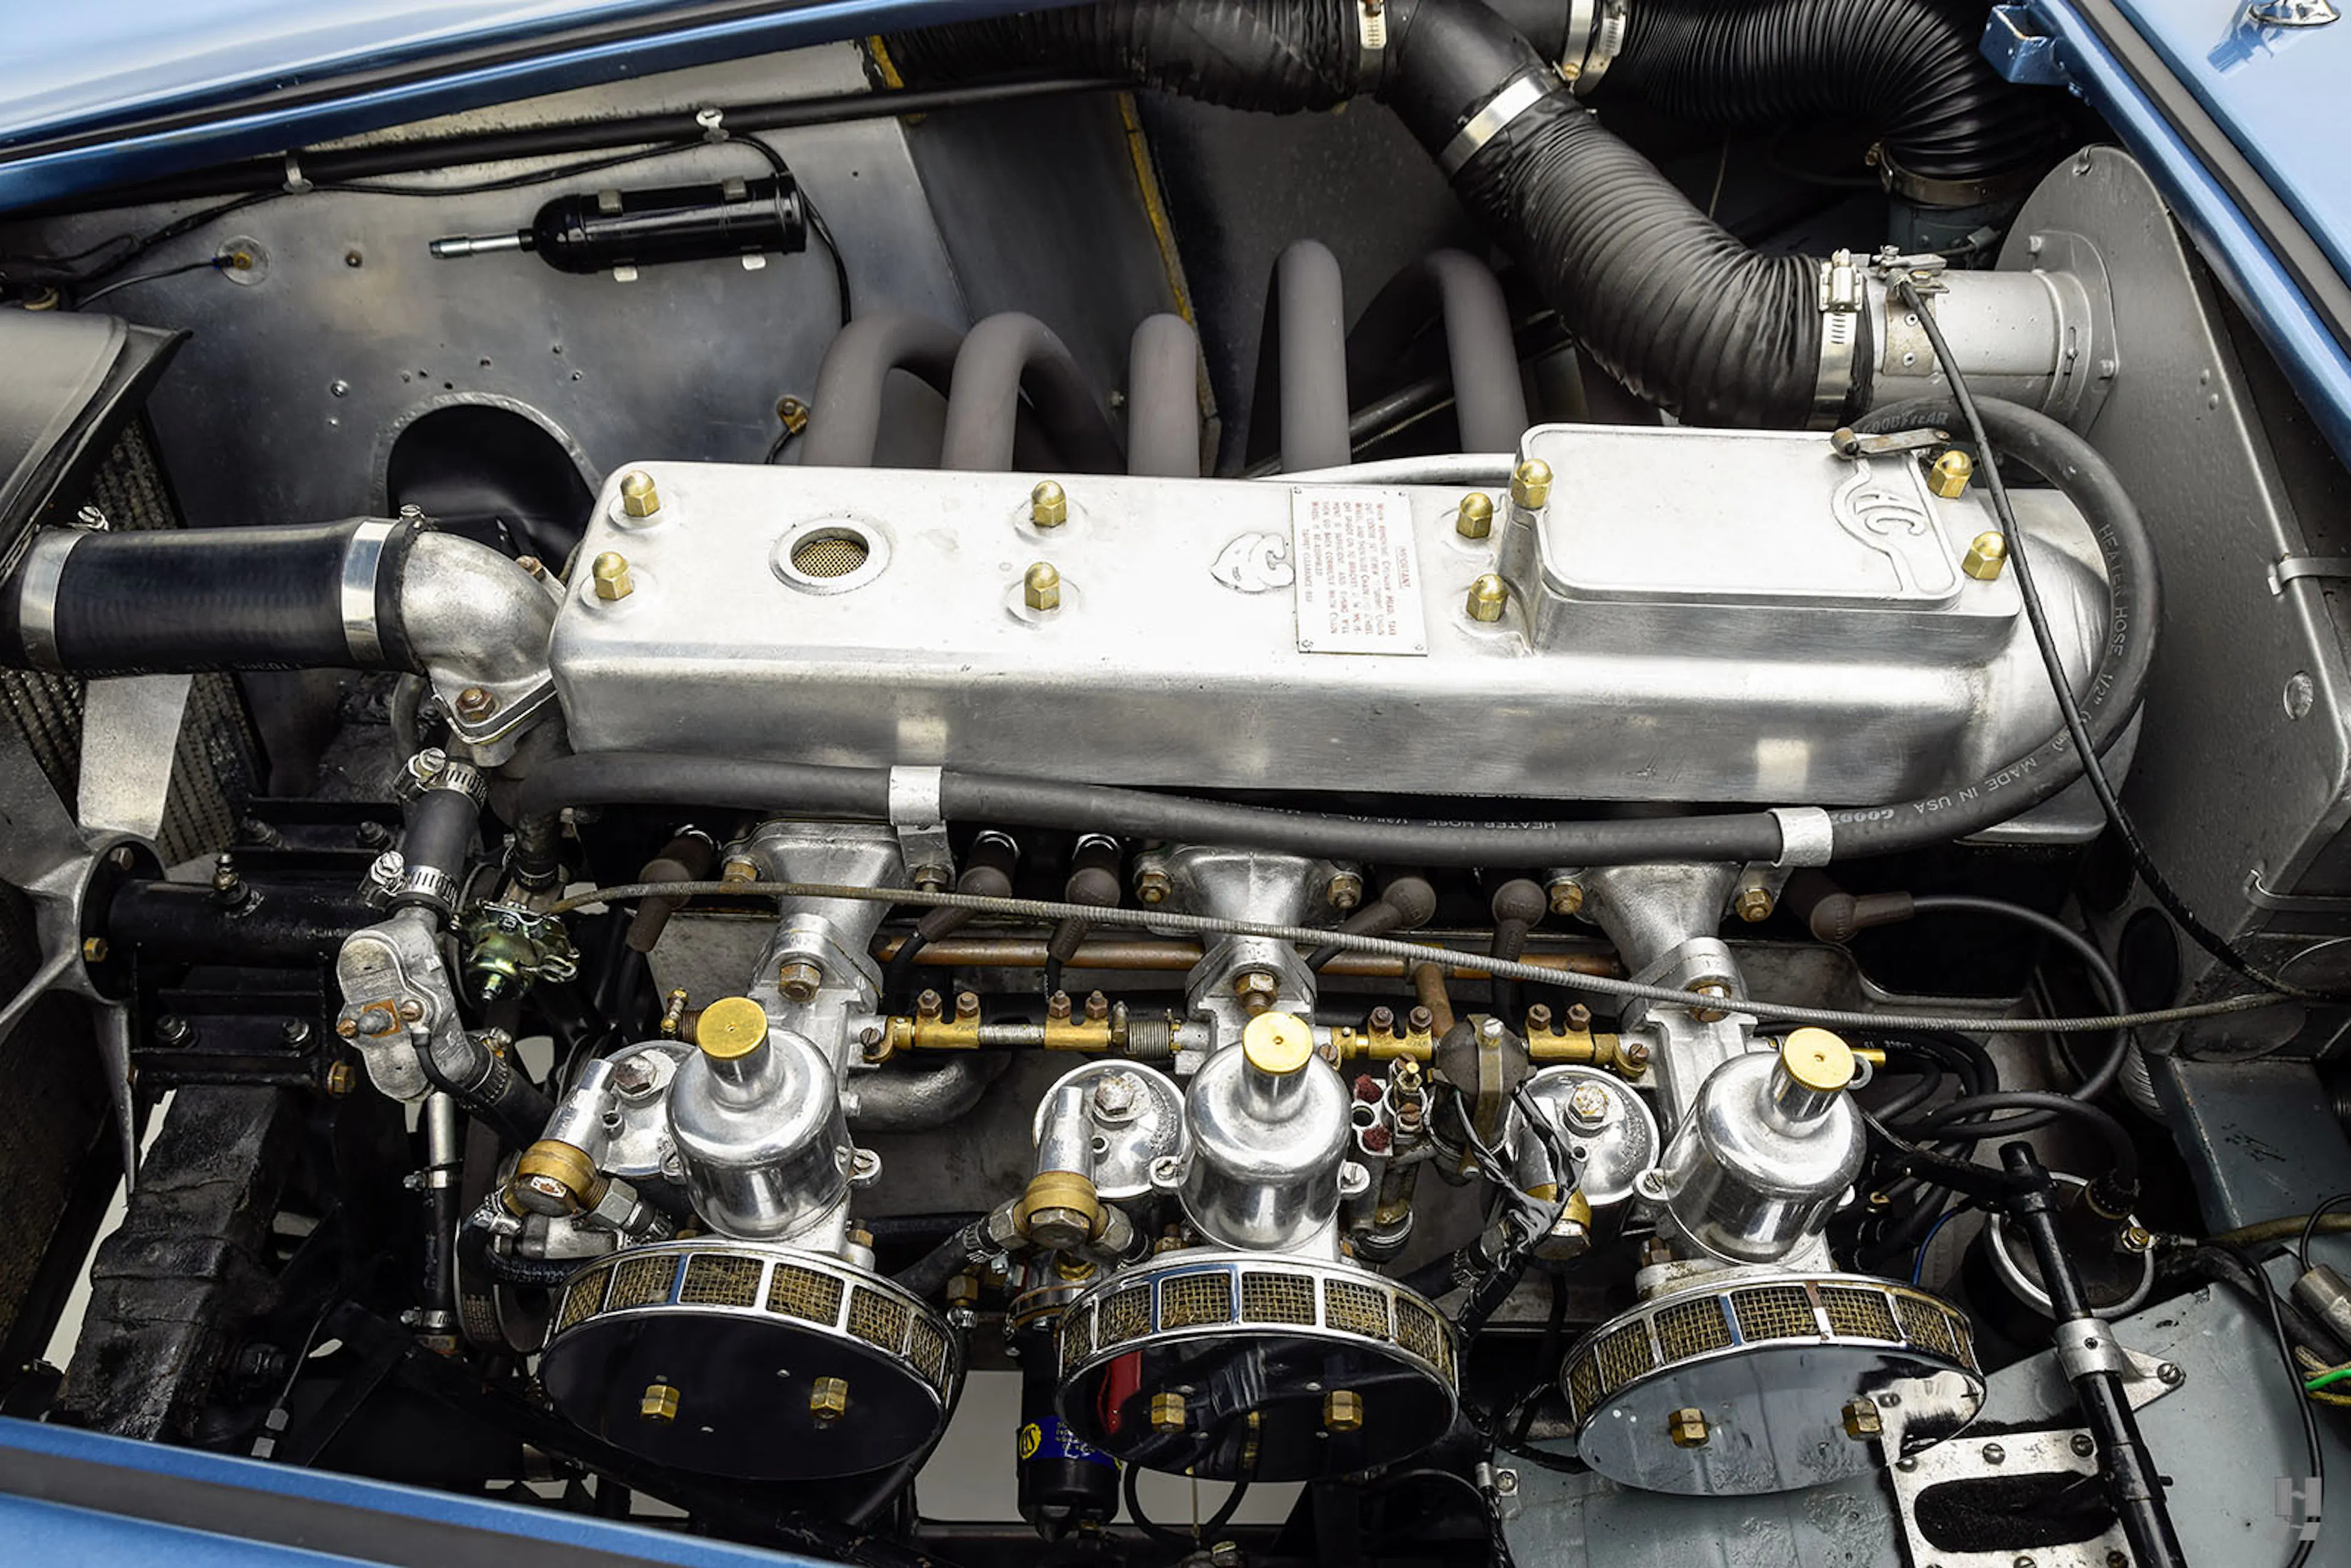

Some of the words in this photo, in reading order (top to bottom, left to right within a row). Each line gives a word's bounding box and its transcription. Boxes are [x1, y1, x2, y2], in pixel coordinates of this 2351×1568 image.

[2097, 523, 2128, 598] HEATER
[2111, 605, 2129, 657] HOSE
[1984, 757, 2038, 793] MADE
[1913, 795, 1952, 815] USA
[1959, 786, 1979, 805] IN
